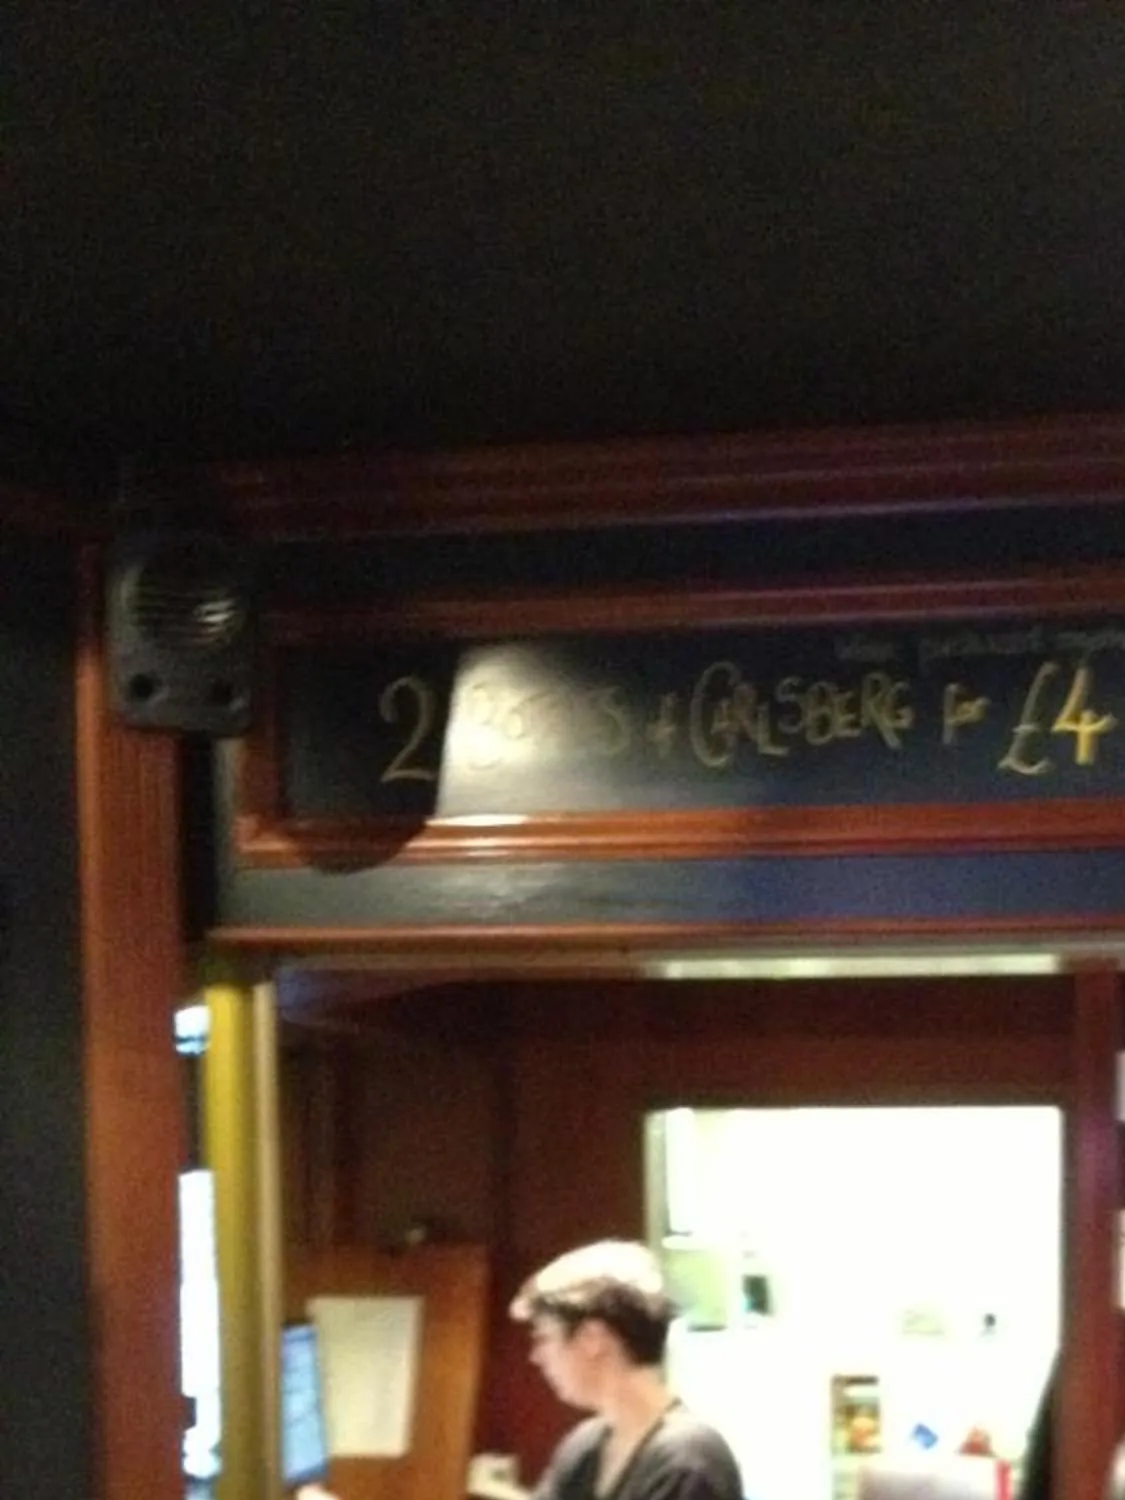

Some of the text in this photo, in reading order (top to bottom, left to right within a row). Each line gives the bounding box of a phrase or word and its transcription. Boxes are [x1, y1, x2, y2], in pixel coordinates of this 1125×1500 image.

[378, 675, 437, 785] 2
[687, 661, 914, 771] CARLSBERG
[997, 661, 1118, 776] £4
